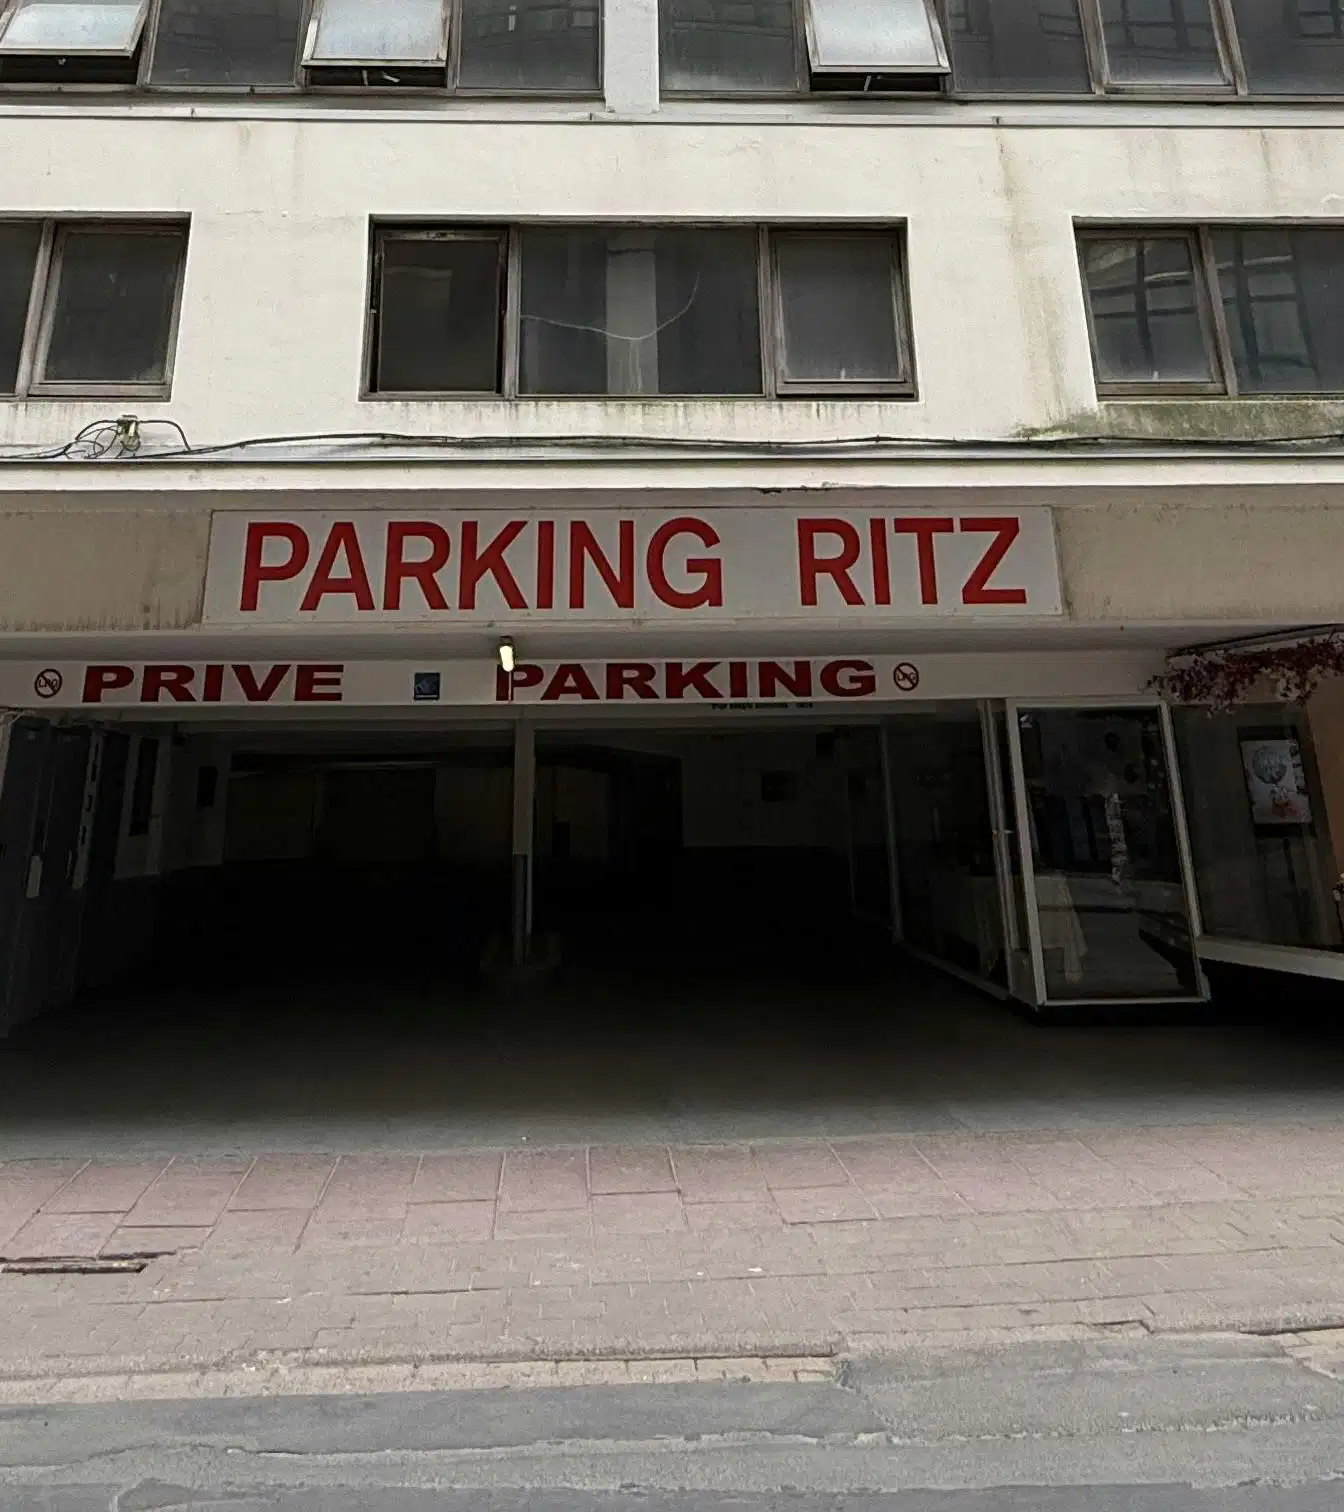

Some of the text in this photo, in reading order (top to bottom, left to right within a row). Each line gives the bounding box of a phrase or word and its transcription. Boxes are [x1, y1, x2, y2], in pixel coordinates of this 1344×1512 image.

[239, 515, 1028, 613] PARKING RITZ
[81, 659, 877, 703] PRIVE PARKING
